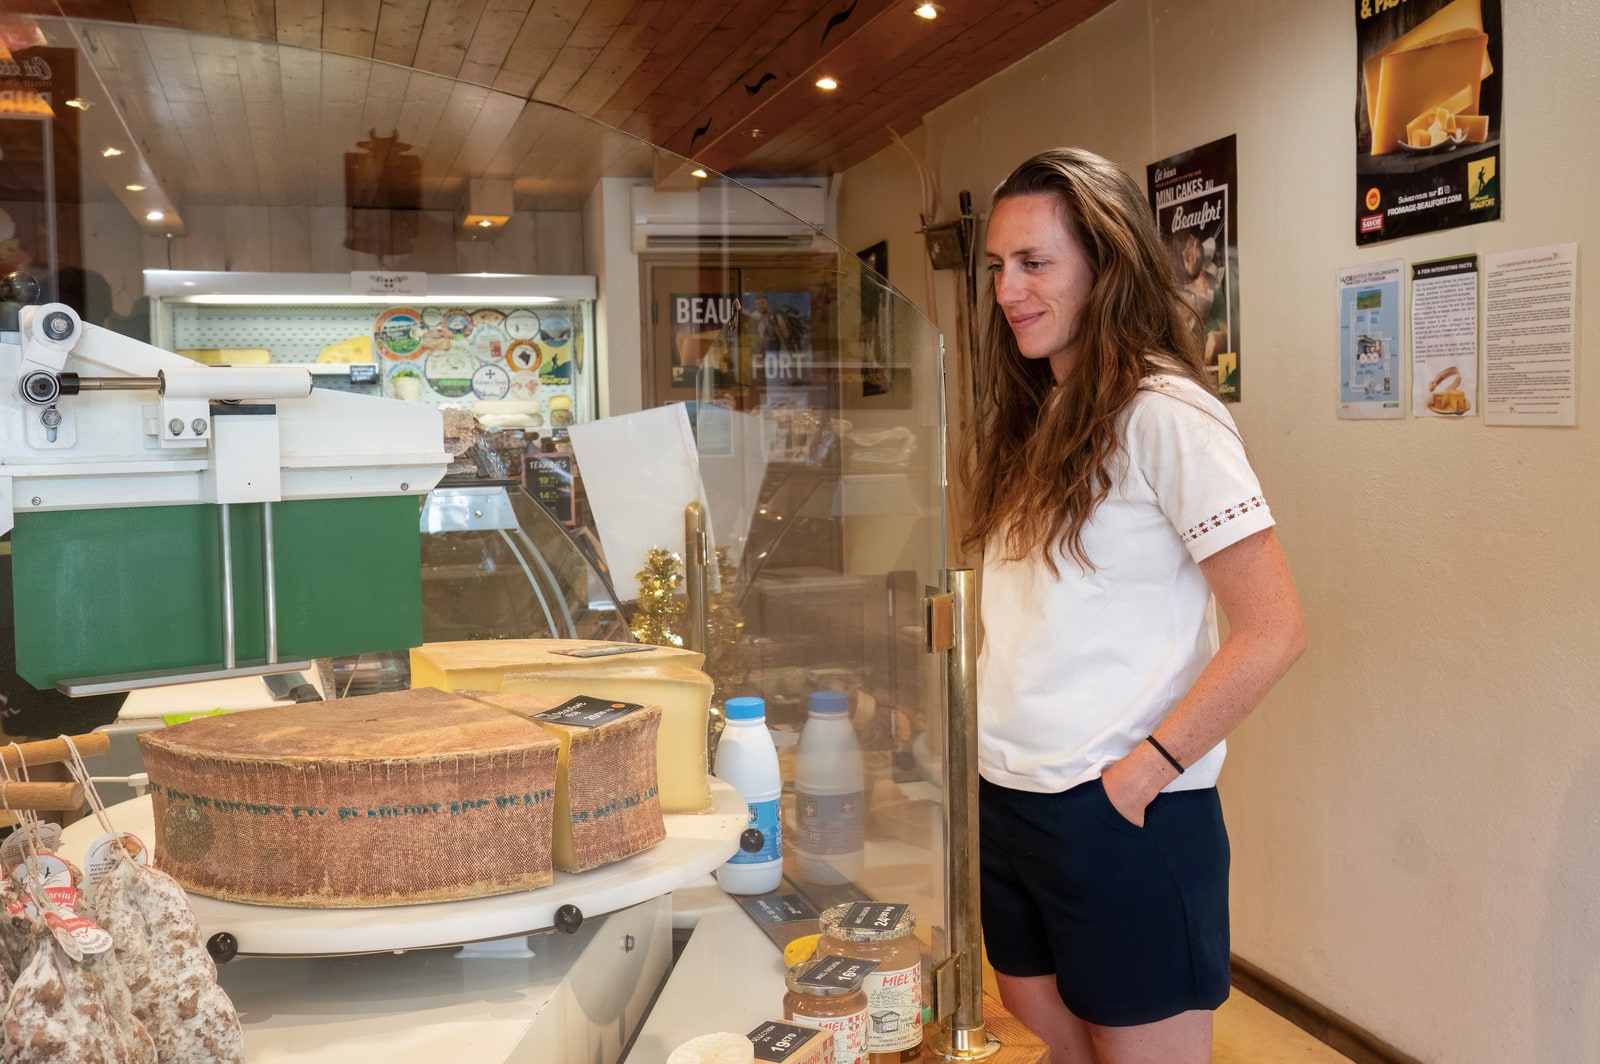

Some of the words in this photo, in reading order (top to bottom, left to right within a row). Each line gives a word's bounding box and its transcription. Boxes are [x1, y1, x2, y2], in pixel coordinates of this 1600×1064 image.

[1156, 185, 1174, 206] MINI
[1176, 178, 1203, 200] CAKES
[1387, 194, 1462, 216] FROMAGE-BEAUFORT.COM
[1171, 199, 1222, 233] Beaufort
[676, 297, 731, 324] BEAU
[752, 353, 806, 380] FORT
[48, 891, 71, 900] arvin
[882, 973, 909, 988] MIEL
